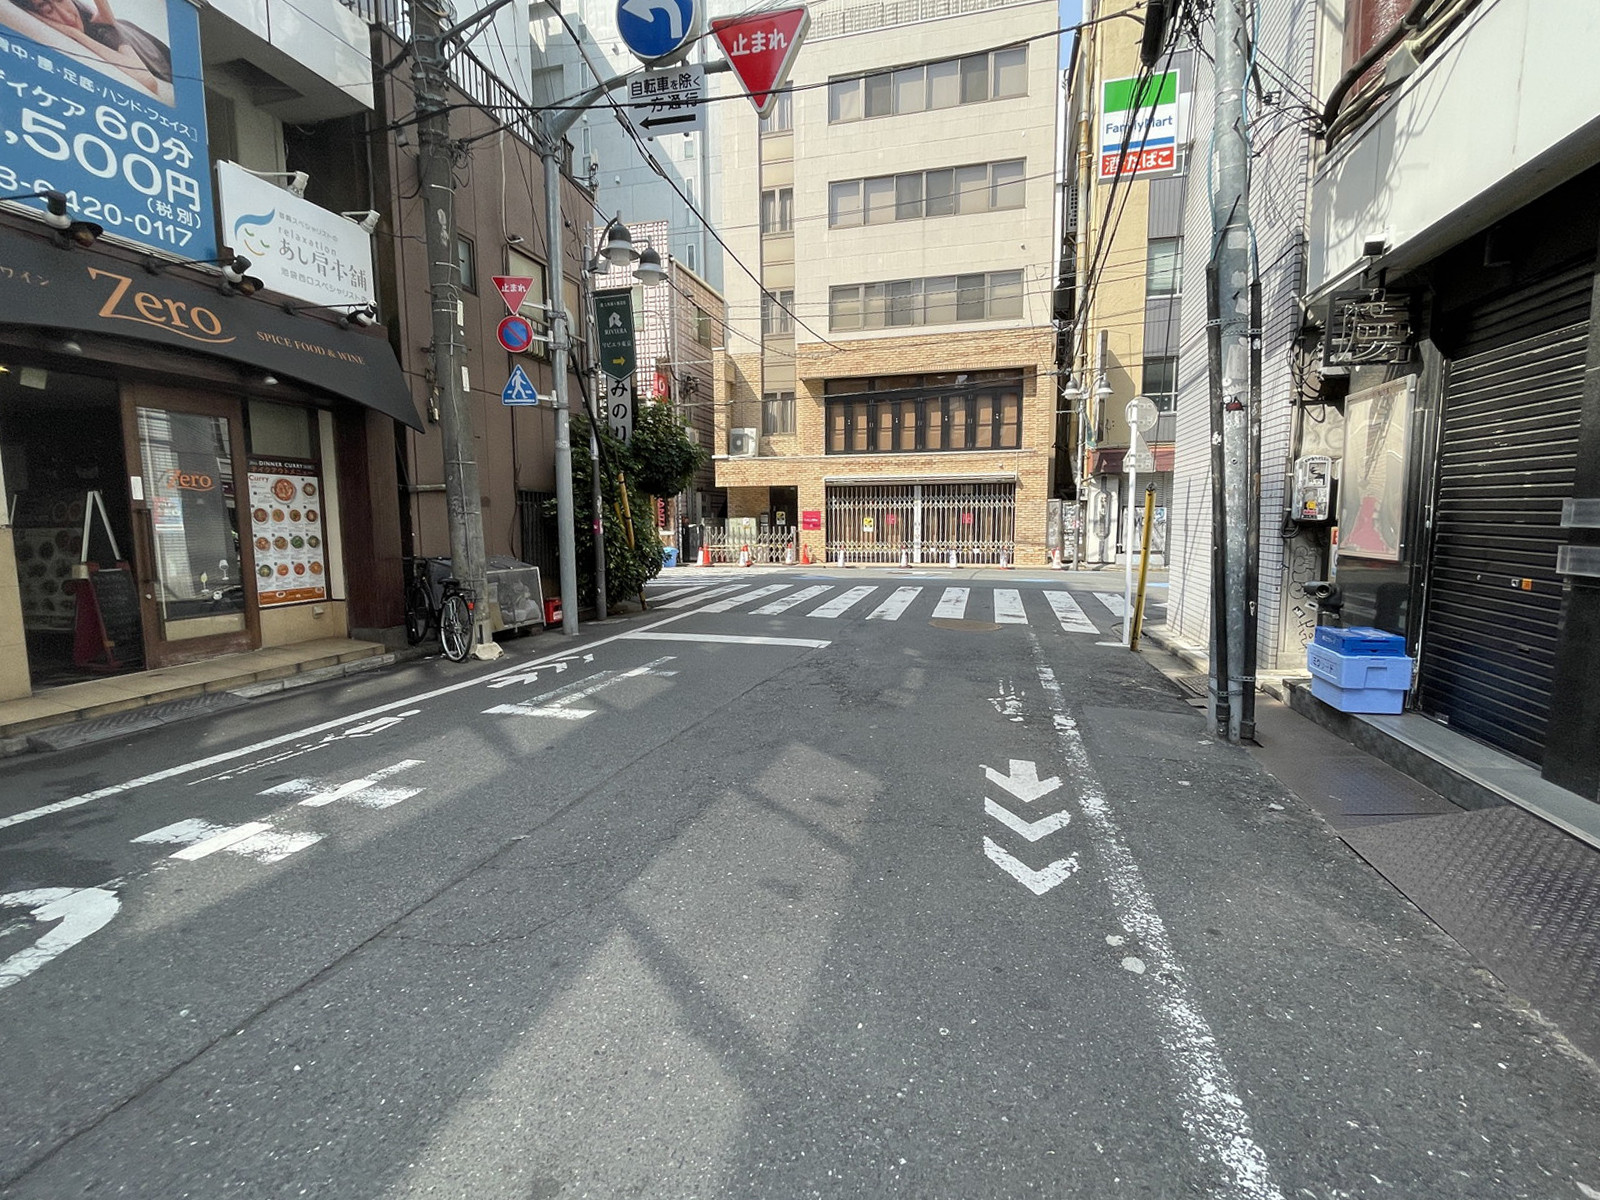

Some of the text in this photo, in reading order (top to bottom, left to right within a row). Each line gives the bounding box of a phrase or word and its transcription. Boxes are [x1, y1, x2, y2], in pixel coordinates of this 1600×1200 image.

[730, 28, 788, 57] 止まれ
[631, 73, 701, 96] 自転車を除く
[634, 92, 699, 113] 一方通行
[95, 105, 194, 169] 60分
[1105, 115, 1173, 134] FamlyMart
[147, 197, 201, 229] (税別)
[278, 226, 337, 256] relaxation
[87, 266, 224, 336] Zero
[501, 284, 527, 293] 止まれ
[256, 331, 366, 366] SPICE FOOD & WINE
[610, 379, 629, 443] みのり
[258, 460, 283, 468] DINNER
[165, 468, 216, 492] Zero
[248, 474, 270, 483] Curry
